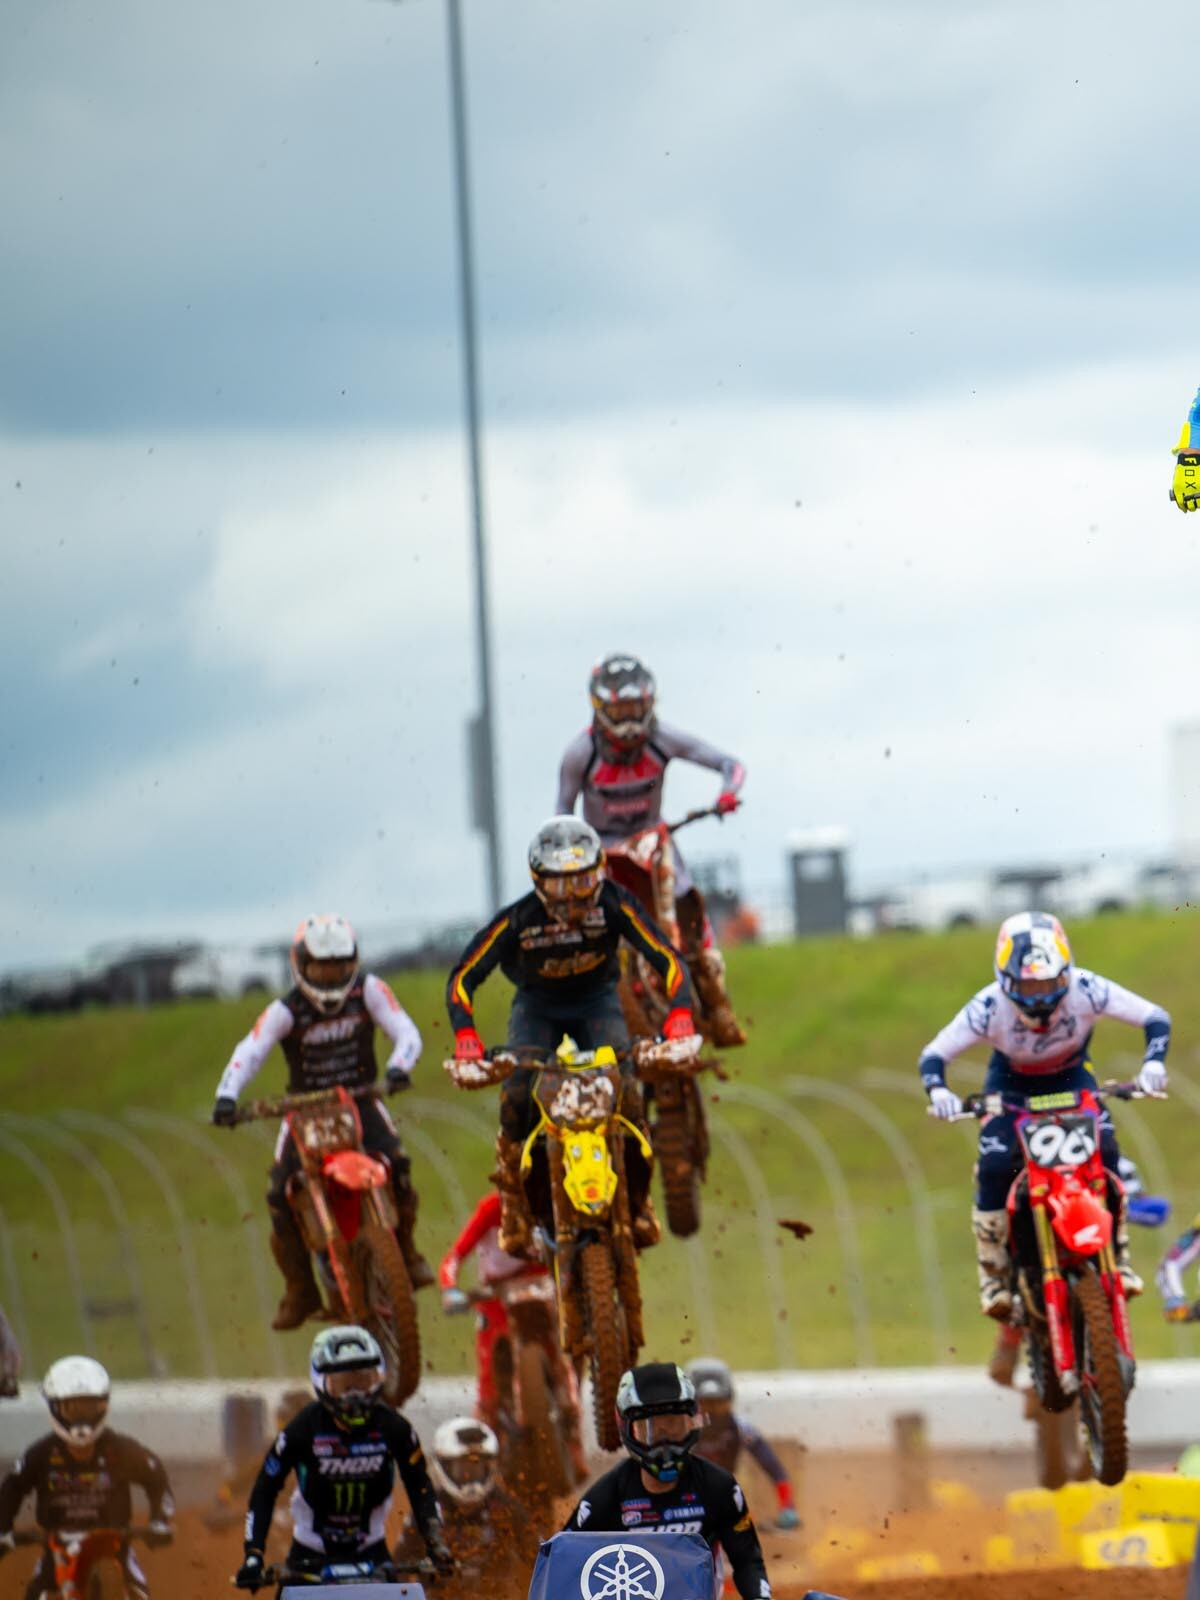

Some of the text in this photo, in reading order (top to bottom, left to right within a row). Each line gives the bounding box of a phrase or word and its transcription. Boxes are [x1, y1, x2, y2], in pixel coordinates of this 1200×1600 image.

[1184, 456, 1198, 490] FOX
[1029, 1124, 1096, 1166] 96
[318, 1455, 385, 1475] THOR
[673, 1506, 705, 1519] YAMAHA
